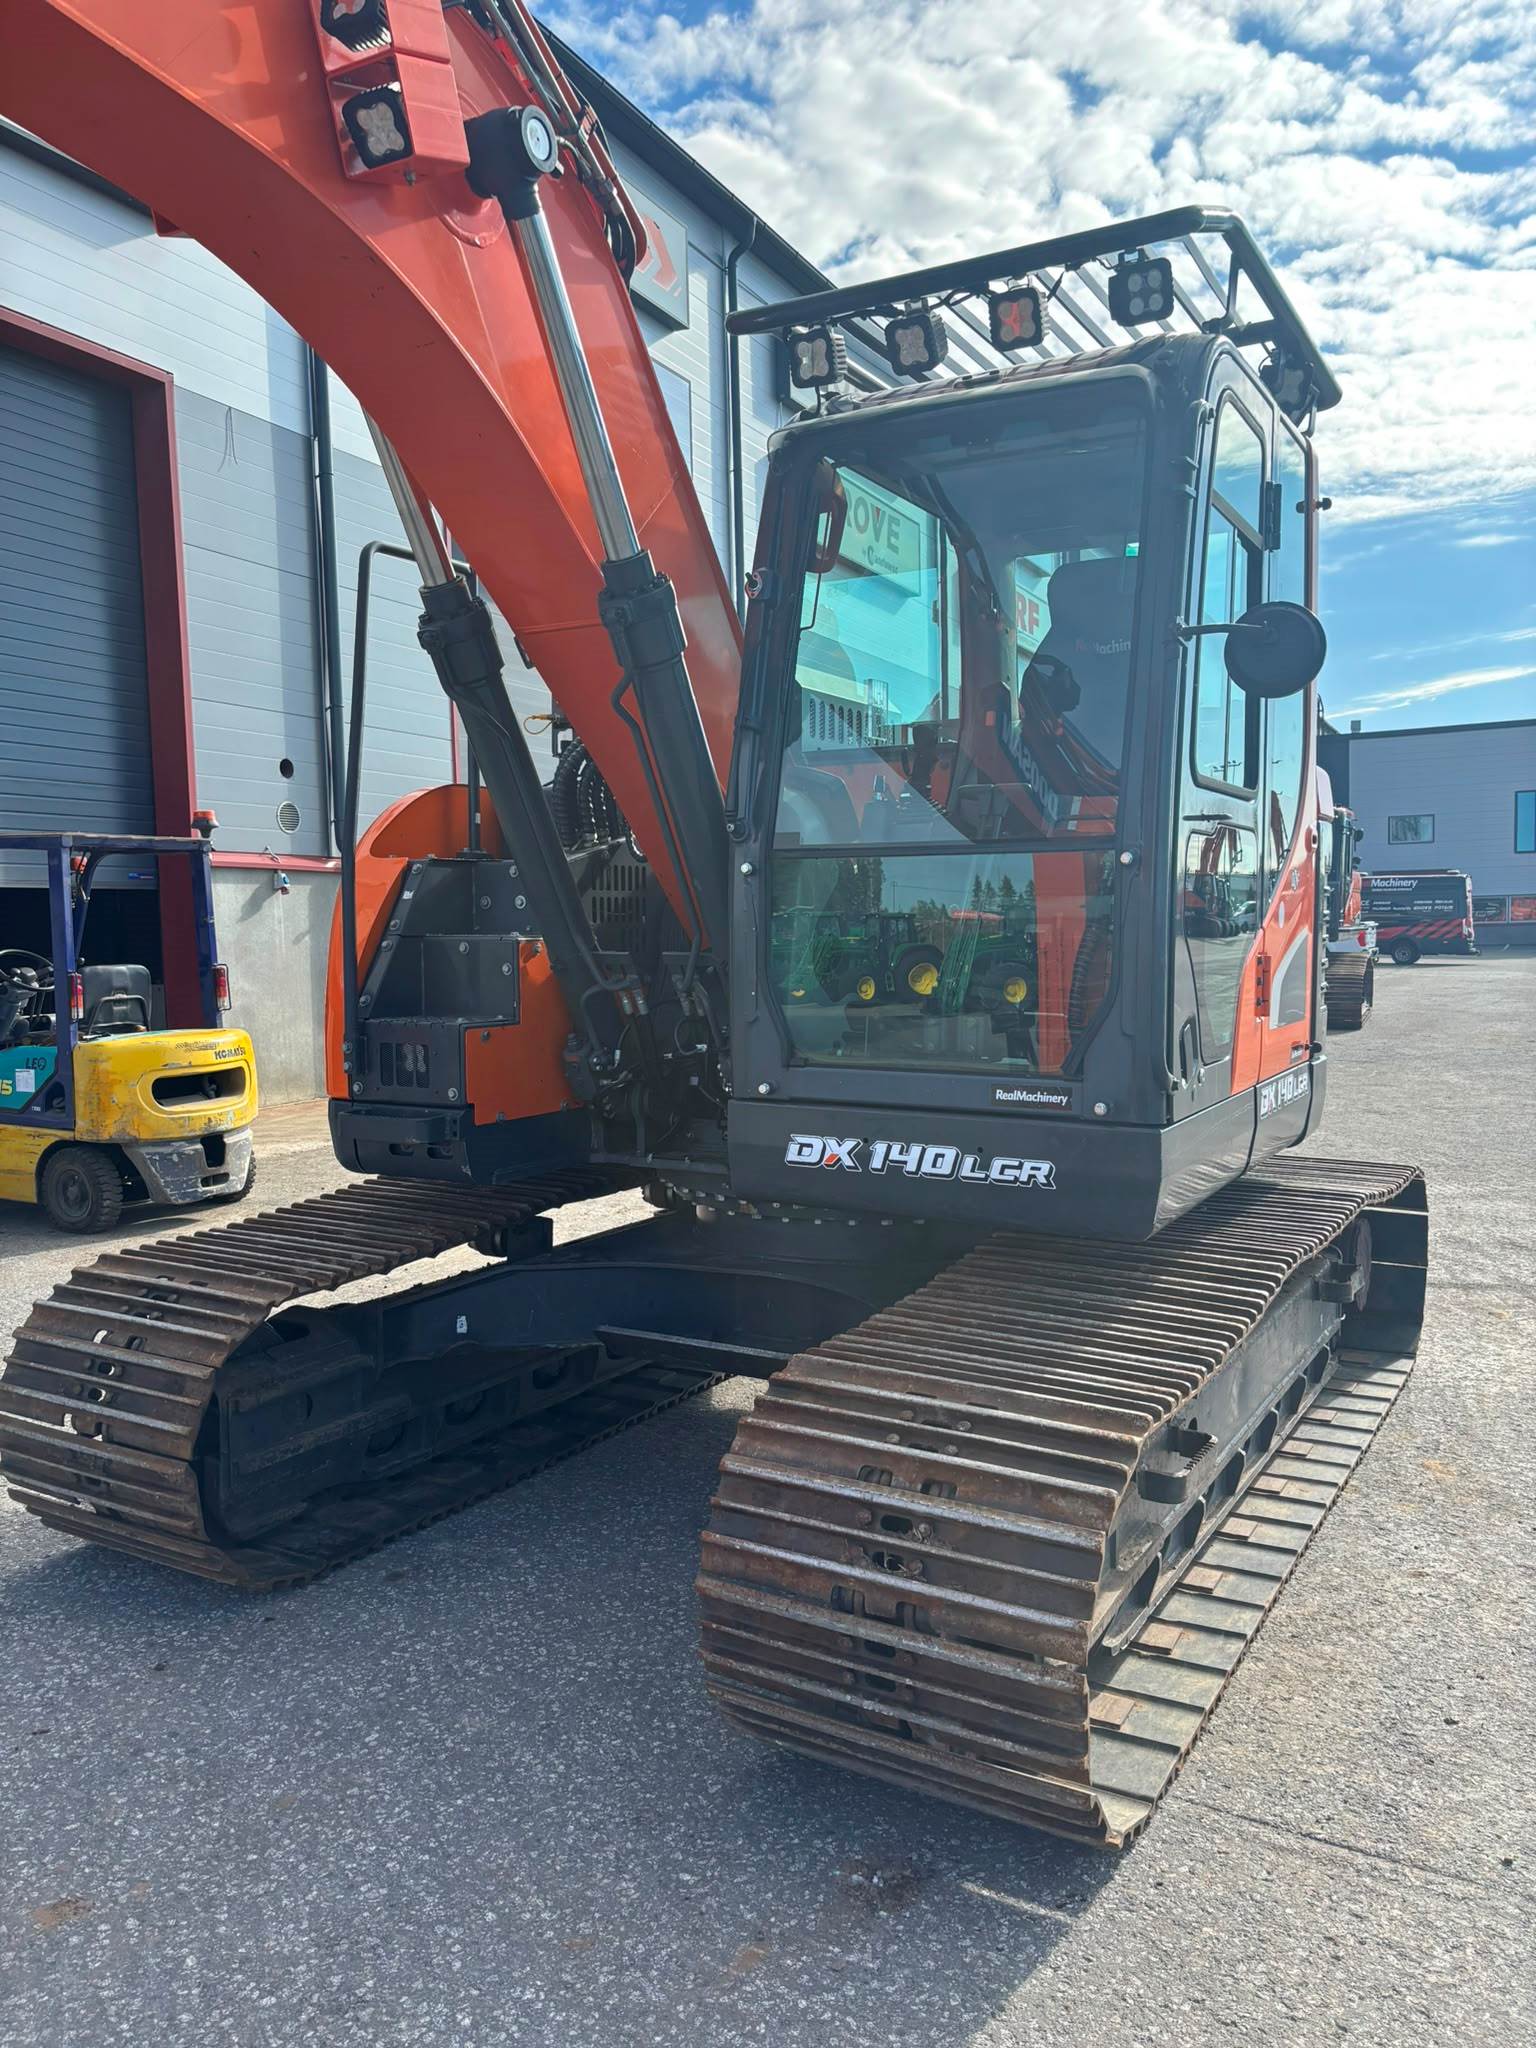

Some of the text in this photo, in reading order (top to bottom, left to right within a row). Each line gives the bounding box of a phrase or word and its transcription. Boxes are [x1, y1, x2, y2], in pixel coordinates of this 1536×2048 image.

[1371, 878, 1418, 888] Machinery
[996, 1089, 1068, 1106] RealMachinery
[785, 1134, 862, 1172] DX
[869, 1141, 960, 1180] 140
